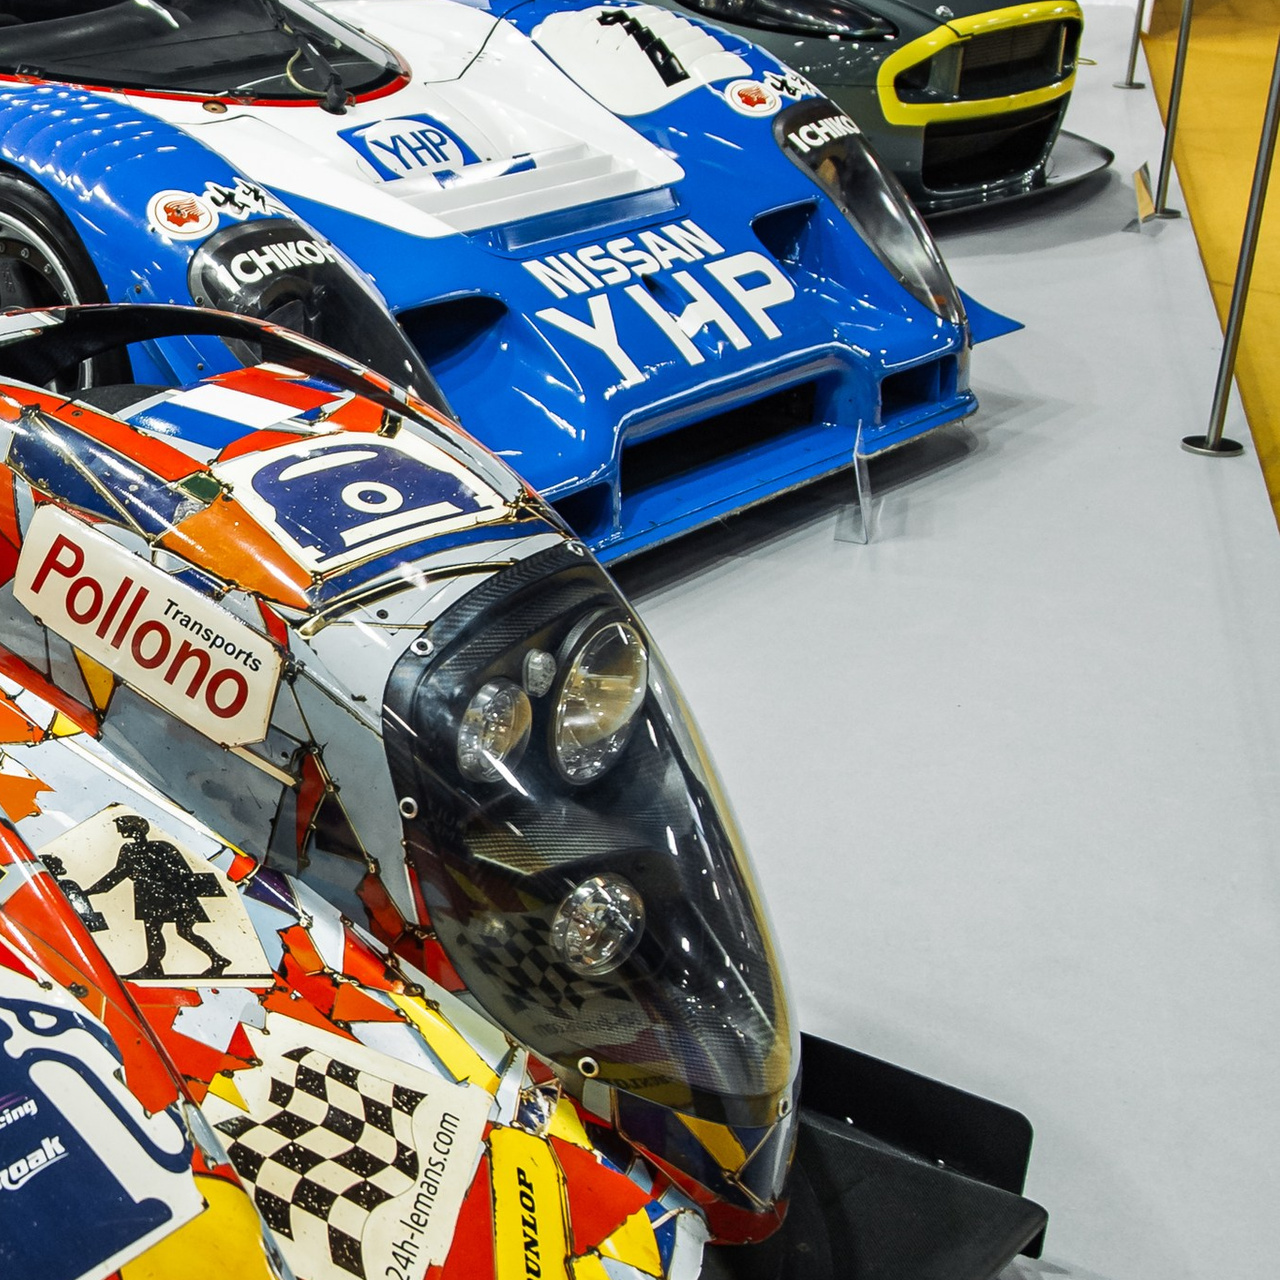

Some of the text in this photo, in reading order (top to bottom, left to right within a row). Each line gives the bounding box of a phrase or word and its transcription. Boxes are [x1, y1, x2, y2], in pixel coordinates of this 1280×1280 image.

[370, 124, 455, 176] YHP
[787, 115, 861, 153] ICHIKO
[521, 218, 725, 300] NISSAN
[537, 250, 797, 388] YHP
[30, 533, 249, 719] Pollono
[162, 598, 263, 672] Transports
